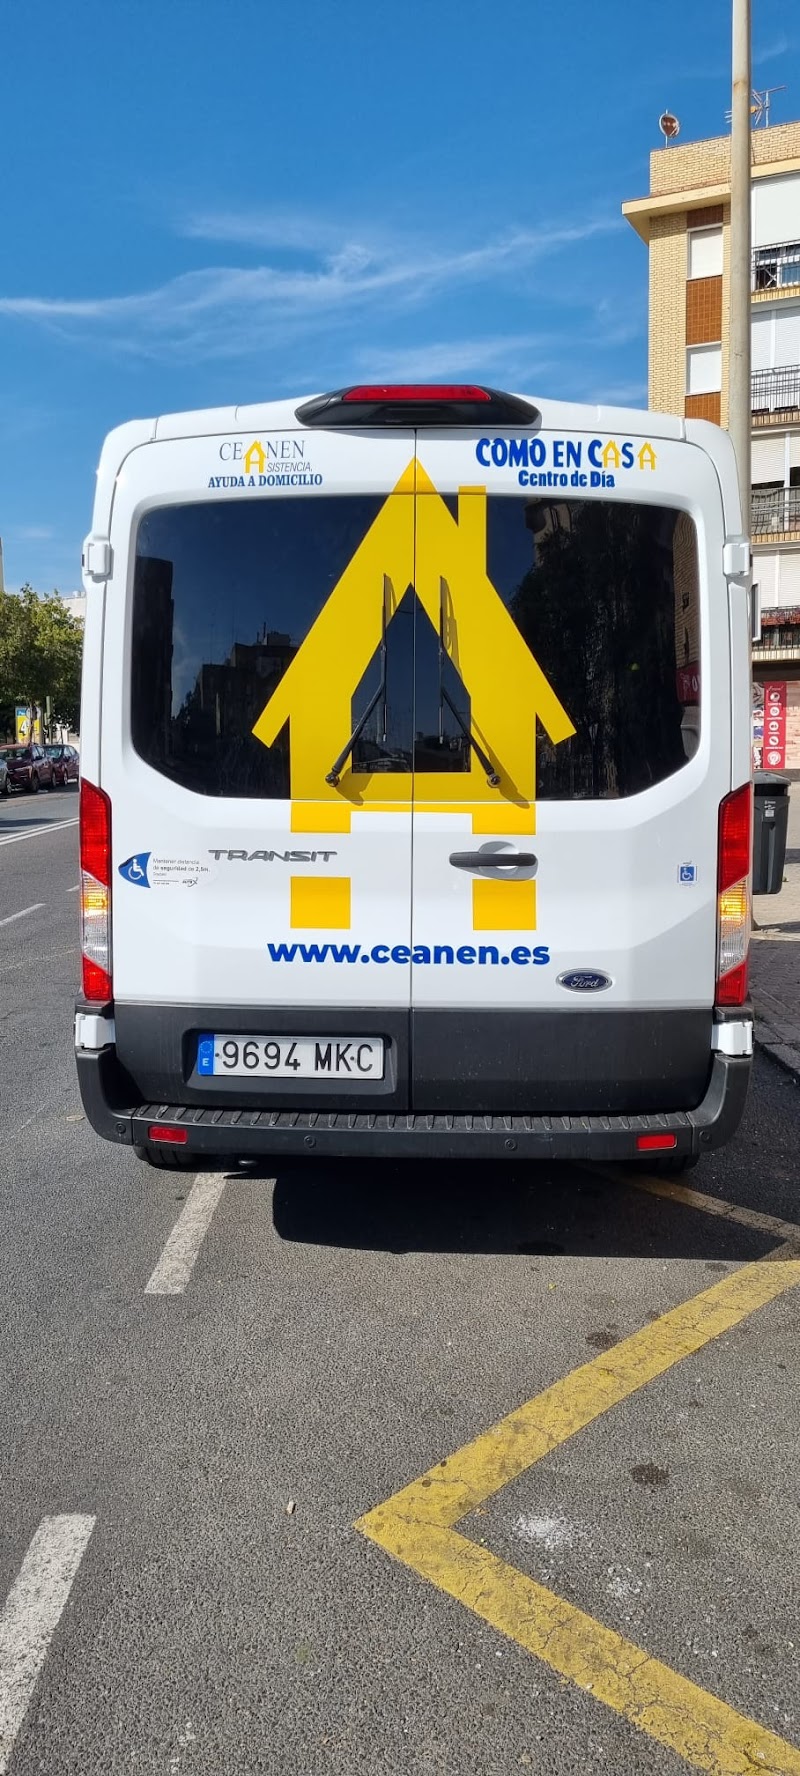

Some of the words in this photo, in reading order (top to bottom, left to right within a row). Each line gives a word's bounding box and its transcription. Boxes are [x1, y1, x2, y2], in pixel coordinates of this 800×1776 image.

[219, 440, 305, 474] CEANEN
[475, 438, 547, 467] COMO
[553, 441, 582, 467] EN
[588, 439, 657, 470] CASA
[208, 476, 246, 488] AYUDA
[248, 476, 256, 487] A
[258, 474, 323, 487] DOMICILIO
[518, 470, 568, 487] Centro
[571, 471, 588, 487] de
[590, 471, 615, 488] Día
[208, 849, 338, 863] TRANSIT
[267, 942, 551, 966] www.ceanen.es
[571, 975, 600, 988] Ford
[202, 1058, 209, 1067] E
[222, 1040, 301, 1071] 9694
[314, 1043, 374, 1072] MKC
